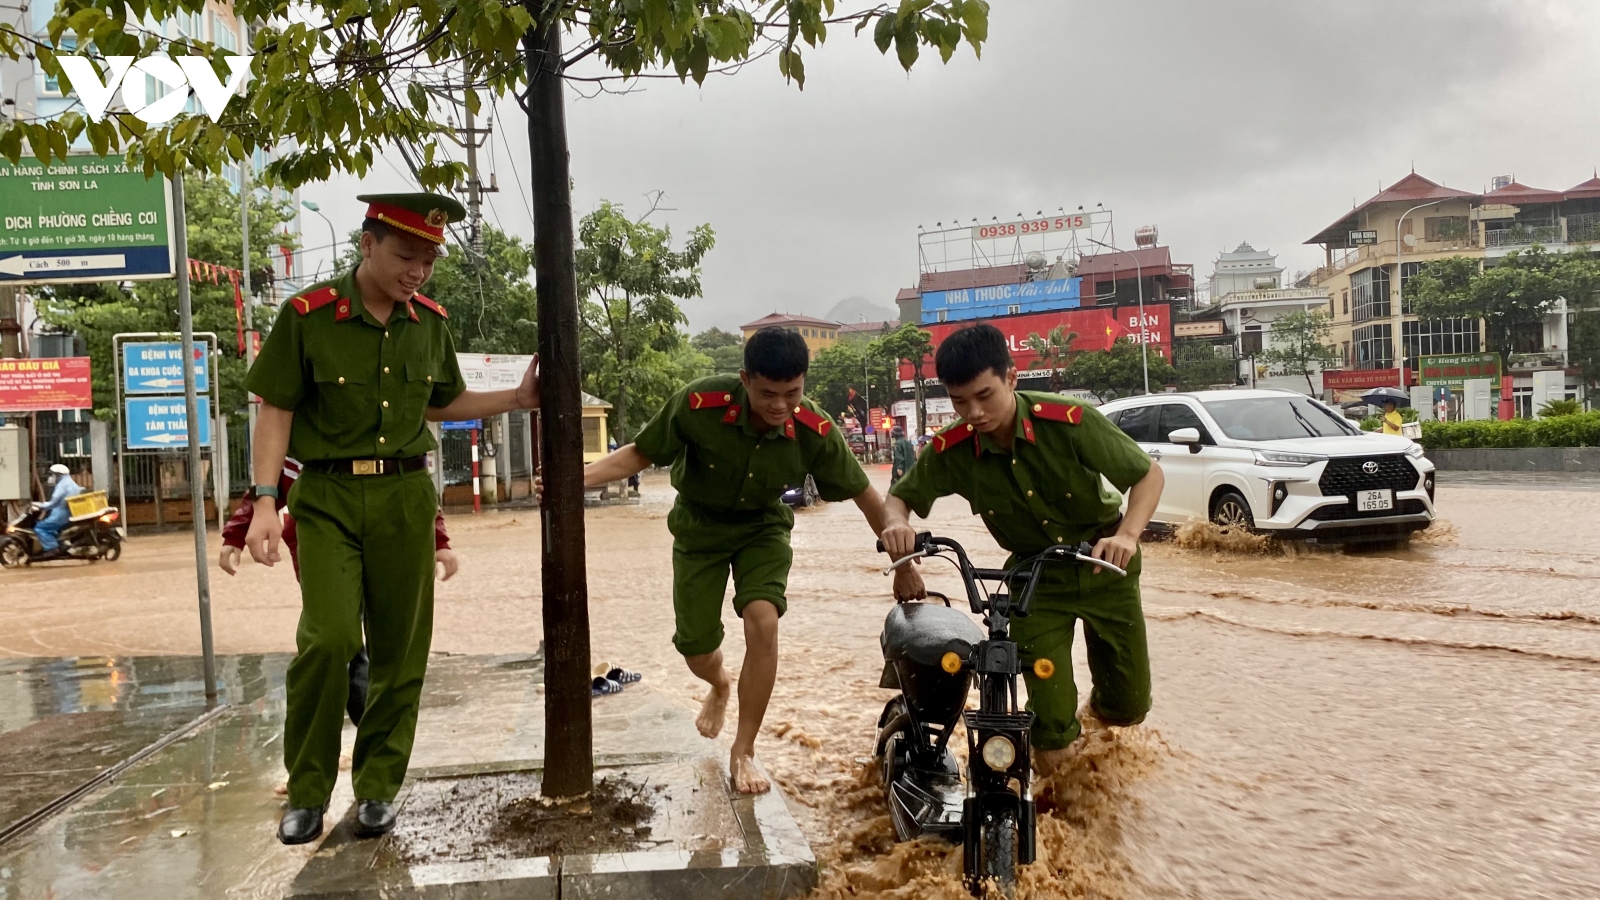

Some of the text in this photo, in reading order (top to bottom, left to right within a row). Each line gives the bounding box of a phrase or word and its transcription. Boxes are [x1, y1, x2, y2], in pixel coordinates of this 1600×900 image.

[14, 164, 43, 176] HÀNG
[47, 163, 78, 175] CHÍNH
[82, 161, 109, 174] SÁCH
[113, 162, 129, 173] XÃ
[31, 177, 98, 191] TỈNH SƠN LA
[5, 206, 158, 231] DỊCH PHƯỜNG CHIỀNG CƠI
[980, 216, 1083, 238] 0938 939 515
[89, 234, 105, 243] ngày
[117, 233, 134, 243] hàng
[135, 232, 155, 242] tháng
[30, 261, 49, 269] Cách
[57, 259, 70, 267] 500
[945, 289, 969, 304] NHÀ
[975, 284, 1012, 301] THUỐC
[1129, 313, 1159, 328] BÁN
[141, 348, 184, 361] BỆNH VIỆ
[141, 367, 160, 376] KHOA
[162, 364, 182, 377] CUỘC
[148, 403, 169, 416] BỆNH
[145, 420, 165, 431] TÂM
[1368, 491, 1382, 500] 26A
[1363, 500, 1389, 509] 165.05
